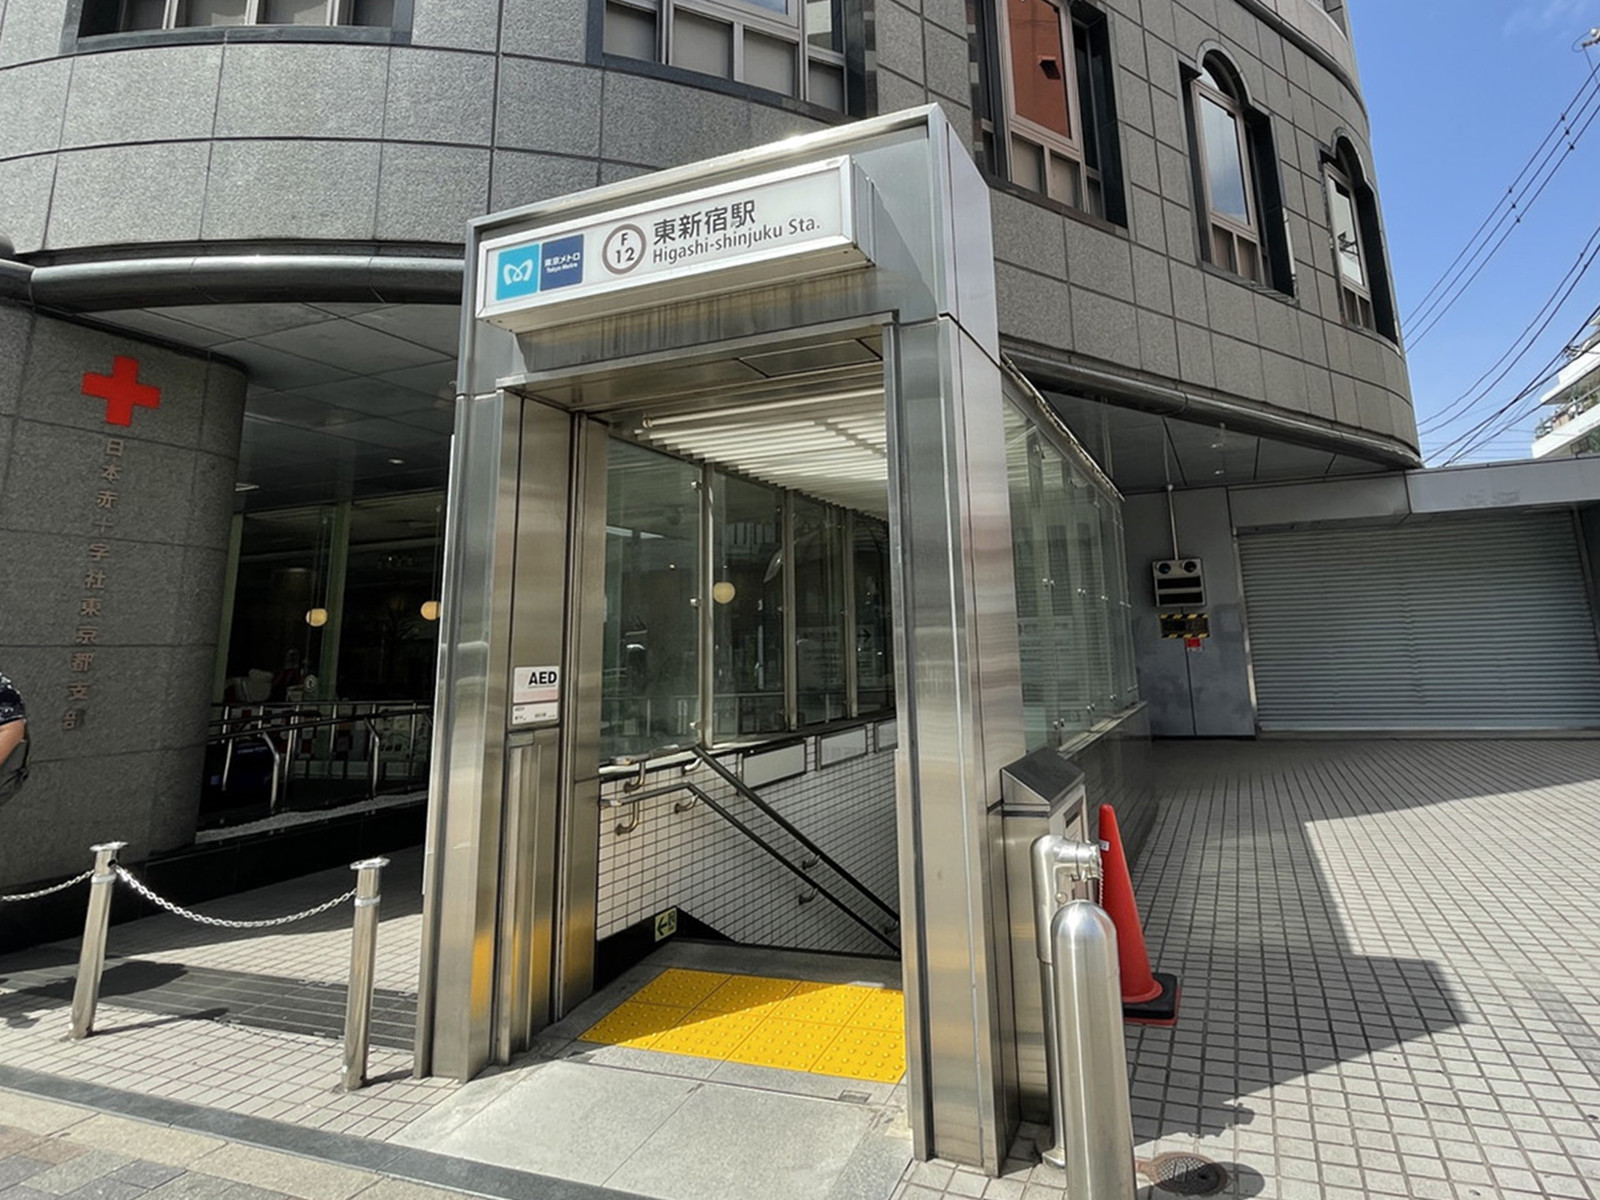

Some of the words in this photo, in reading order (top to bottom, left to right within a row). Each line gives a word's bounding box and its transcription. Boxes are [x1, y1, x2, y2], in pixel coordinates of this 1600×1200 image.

[652, 199, 756, 247] 東新宿駅
[620, 231, 629, 247] F
[652, 224, 783, 265] Higashi-shinjuku
[788, 217, 821, 236] Sta.
[544, 252, 581, 267] 東京メトロ
[615, 246, 636, 264] 12
[528, 671, 557, 686] AED
